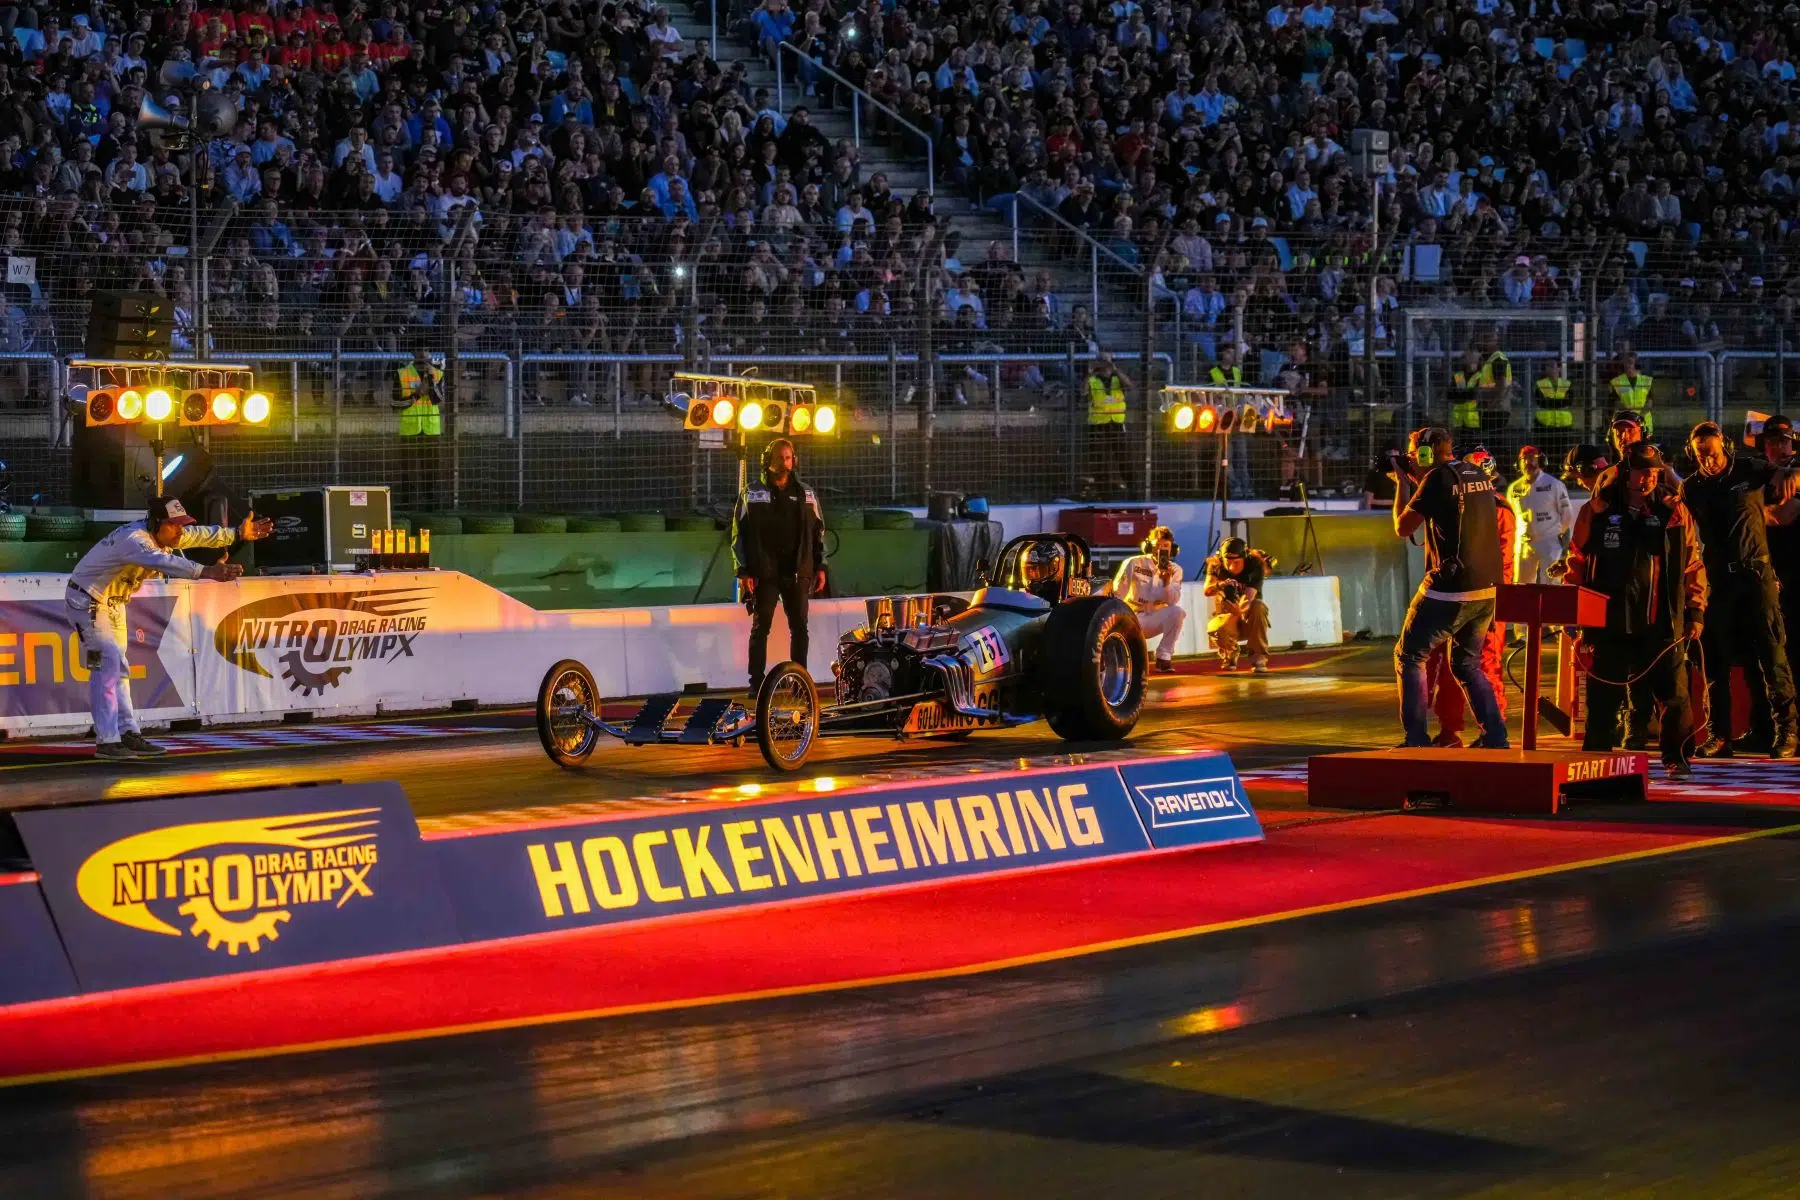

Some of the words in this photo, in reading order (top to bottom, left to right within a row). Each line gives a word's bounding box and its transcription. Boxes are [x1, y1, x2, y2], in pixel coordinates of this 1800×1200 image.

[1452, 480, 1495, 496] MEDIA
[338, 618, 377, 636] DRAG
[380, 616, 427, 634] RACING
[972, 631, 1004, 664] 757
[1567, 759, 1606, 782] START
[1608, 755, 1636, 777] LINE
[1153, 790, 1235, 815] RAVENOL
[254, 851, 308, 875] DRAG
[311, 844, 378, 867] RACING
[527, 783, 1105, 918] HOCKENHEIMRING
